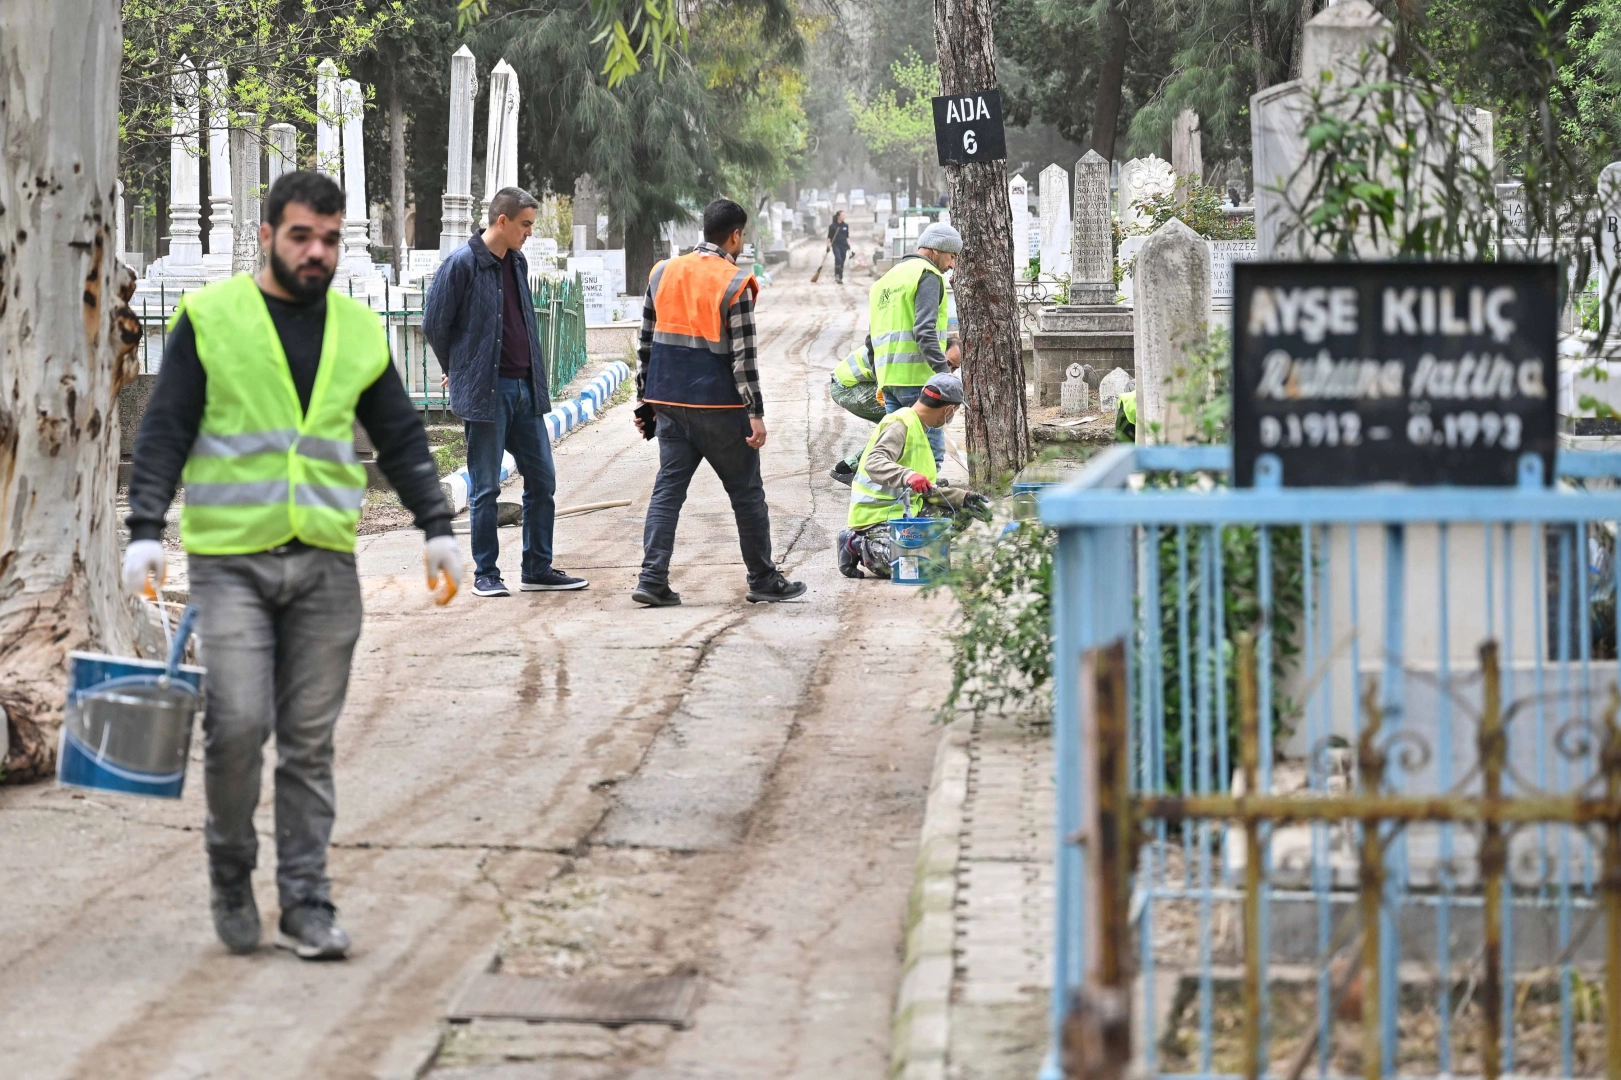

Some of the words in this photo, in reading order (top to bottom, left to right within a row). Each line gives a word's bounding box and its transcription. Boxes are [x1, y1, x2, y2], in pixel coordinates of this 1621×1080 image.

[946, 96, 991, 124] ADA
[963, 129, 978, 155] 6
[1213, 242, 1257, 251] MUAZZEZ
[582, 275, 598, 284] SNÜ
[1213, 287, 1233, 295] uhlar
[1248, 286, 1359, 344] AYŞE
[1381, 285, 1518, 344] KILIÇ
[1256, 348, 1405, 399] Ruhuna
